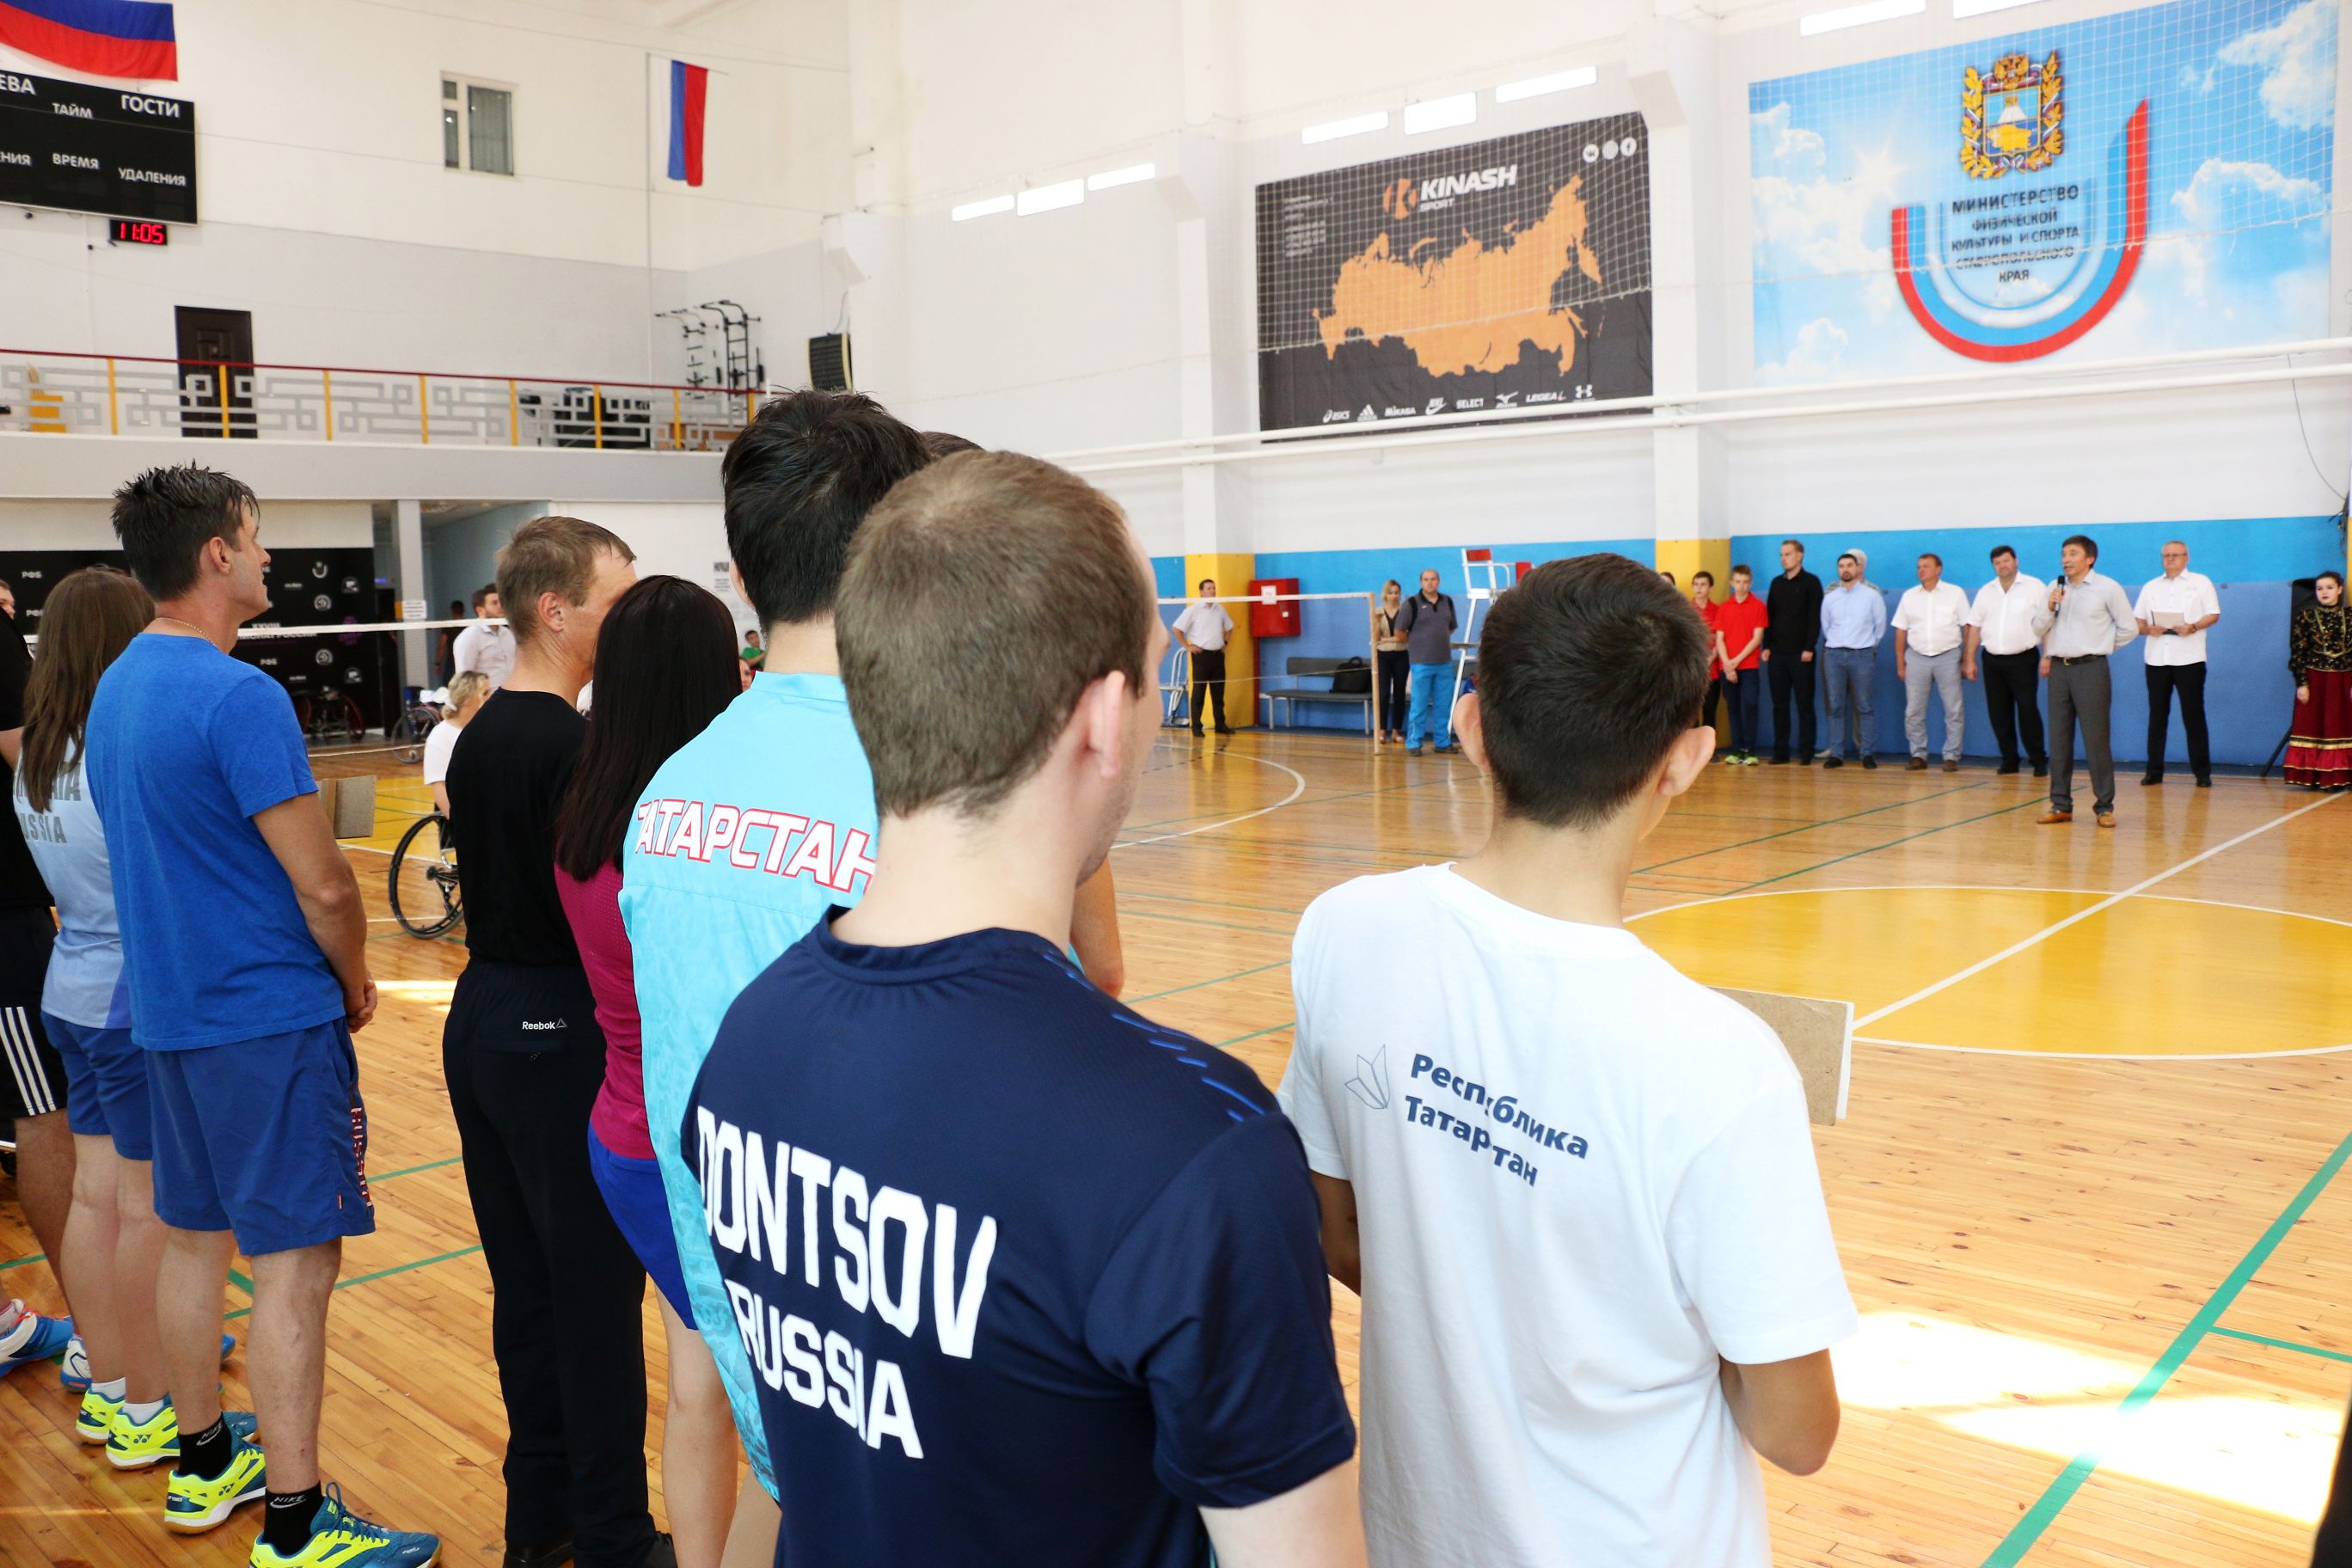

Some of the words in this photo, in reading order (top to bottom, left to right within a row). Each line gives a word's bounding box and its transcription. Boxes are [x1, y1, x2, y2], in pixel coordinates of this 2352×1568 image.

[52, 102, 94, 119] ТАЙМ
[120, 95, 180, 118] ГОСТИ
[0, 150, 33, 166] НИЯ
[52, 153, 99, 169] ВРЕМЯ
[118, 167, 187, 186] УДАЛЕНИЯ
[1420, 164, 1518, 201] KINASH
[1419, 199, 1455, 212] SPORT
[1952, 185, 2079, 214] МИНИСТЕРСТВО
[1972, 207, 2058, 231] ФИЗИЧЕСКОЙ
[119, 222, 164, 245] 11:05
[1951, 234, 2012, 251] КУЛЬТУРЫ
[2019, 233, 2029, 243] И
[2031, 226, 2079, 242] СПОРТА
[1999, 269, 2030, 282] КРАЯ
[522, 1020, 556, 1030] Reebok
[1405, 1095, 1539, 1187] Татартан
[697, 1106, 997, 1360] DONTSOV
[725, 1279, 924, 1460] RUSSIA
[274, 1495, 305, 1504] NIKE
